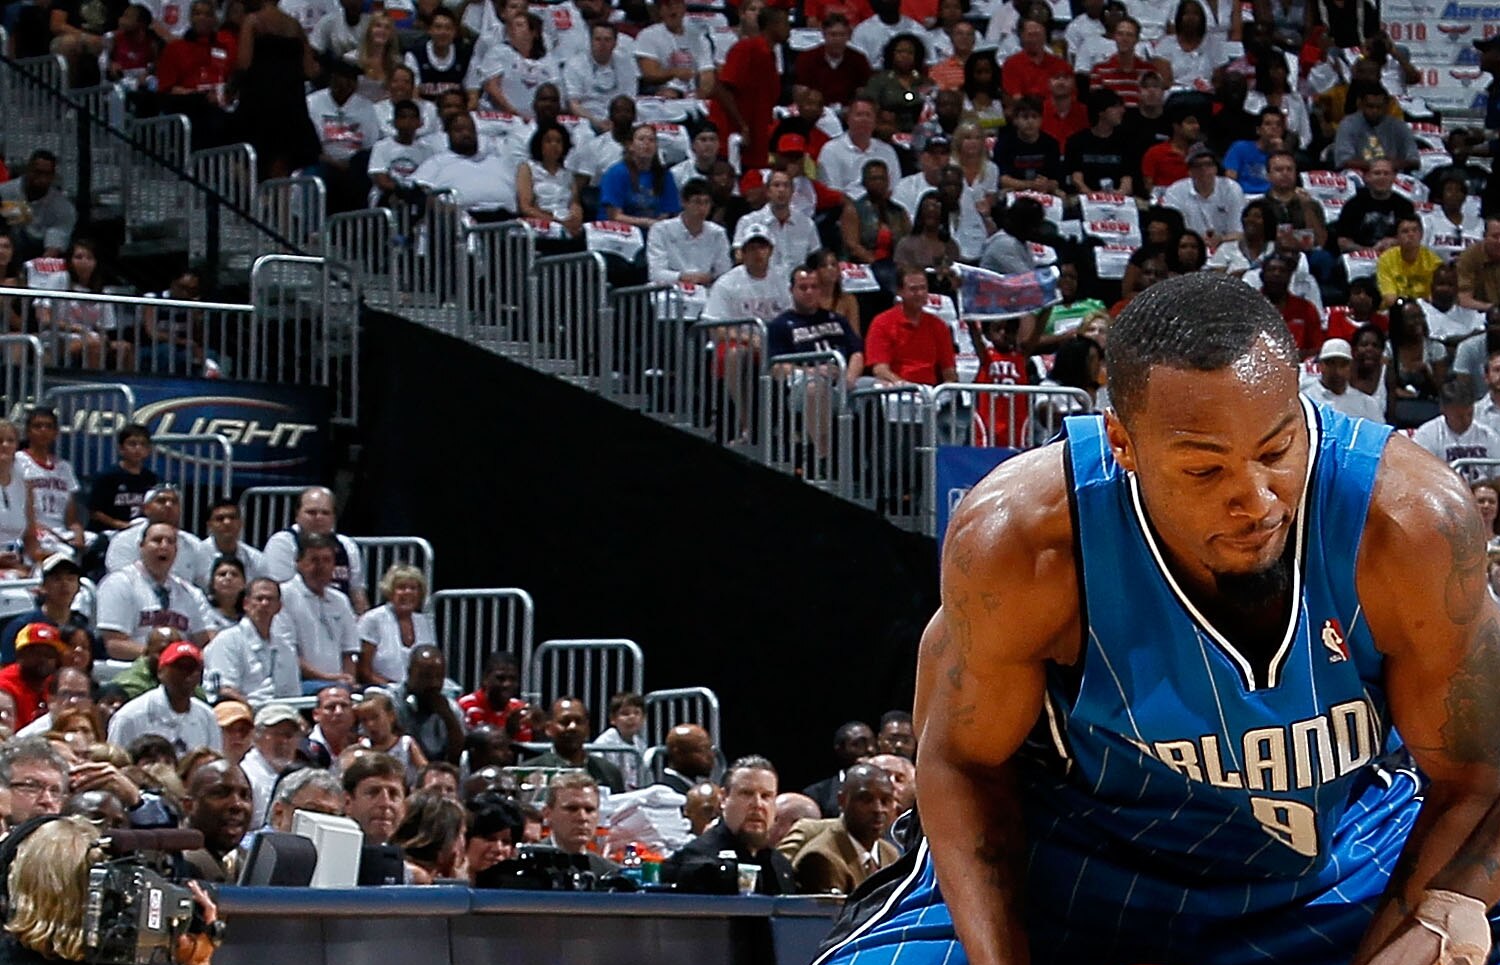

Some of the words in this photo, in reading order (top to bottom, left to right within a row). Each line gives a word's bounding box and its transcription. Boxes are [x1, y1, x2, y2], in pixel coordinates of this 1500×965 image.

[1090, 220, 1130, 233] KNOW
[152, 412, 318, 447] LIGHT
[1125, 700, 1382, 792] RLAND
[1250, 796, 1319, 858] 9
